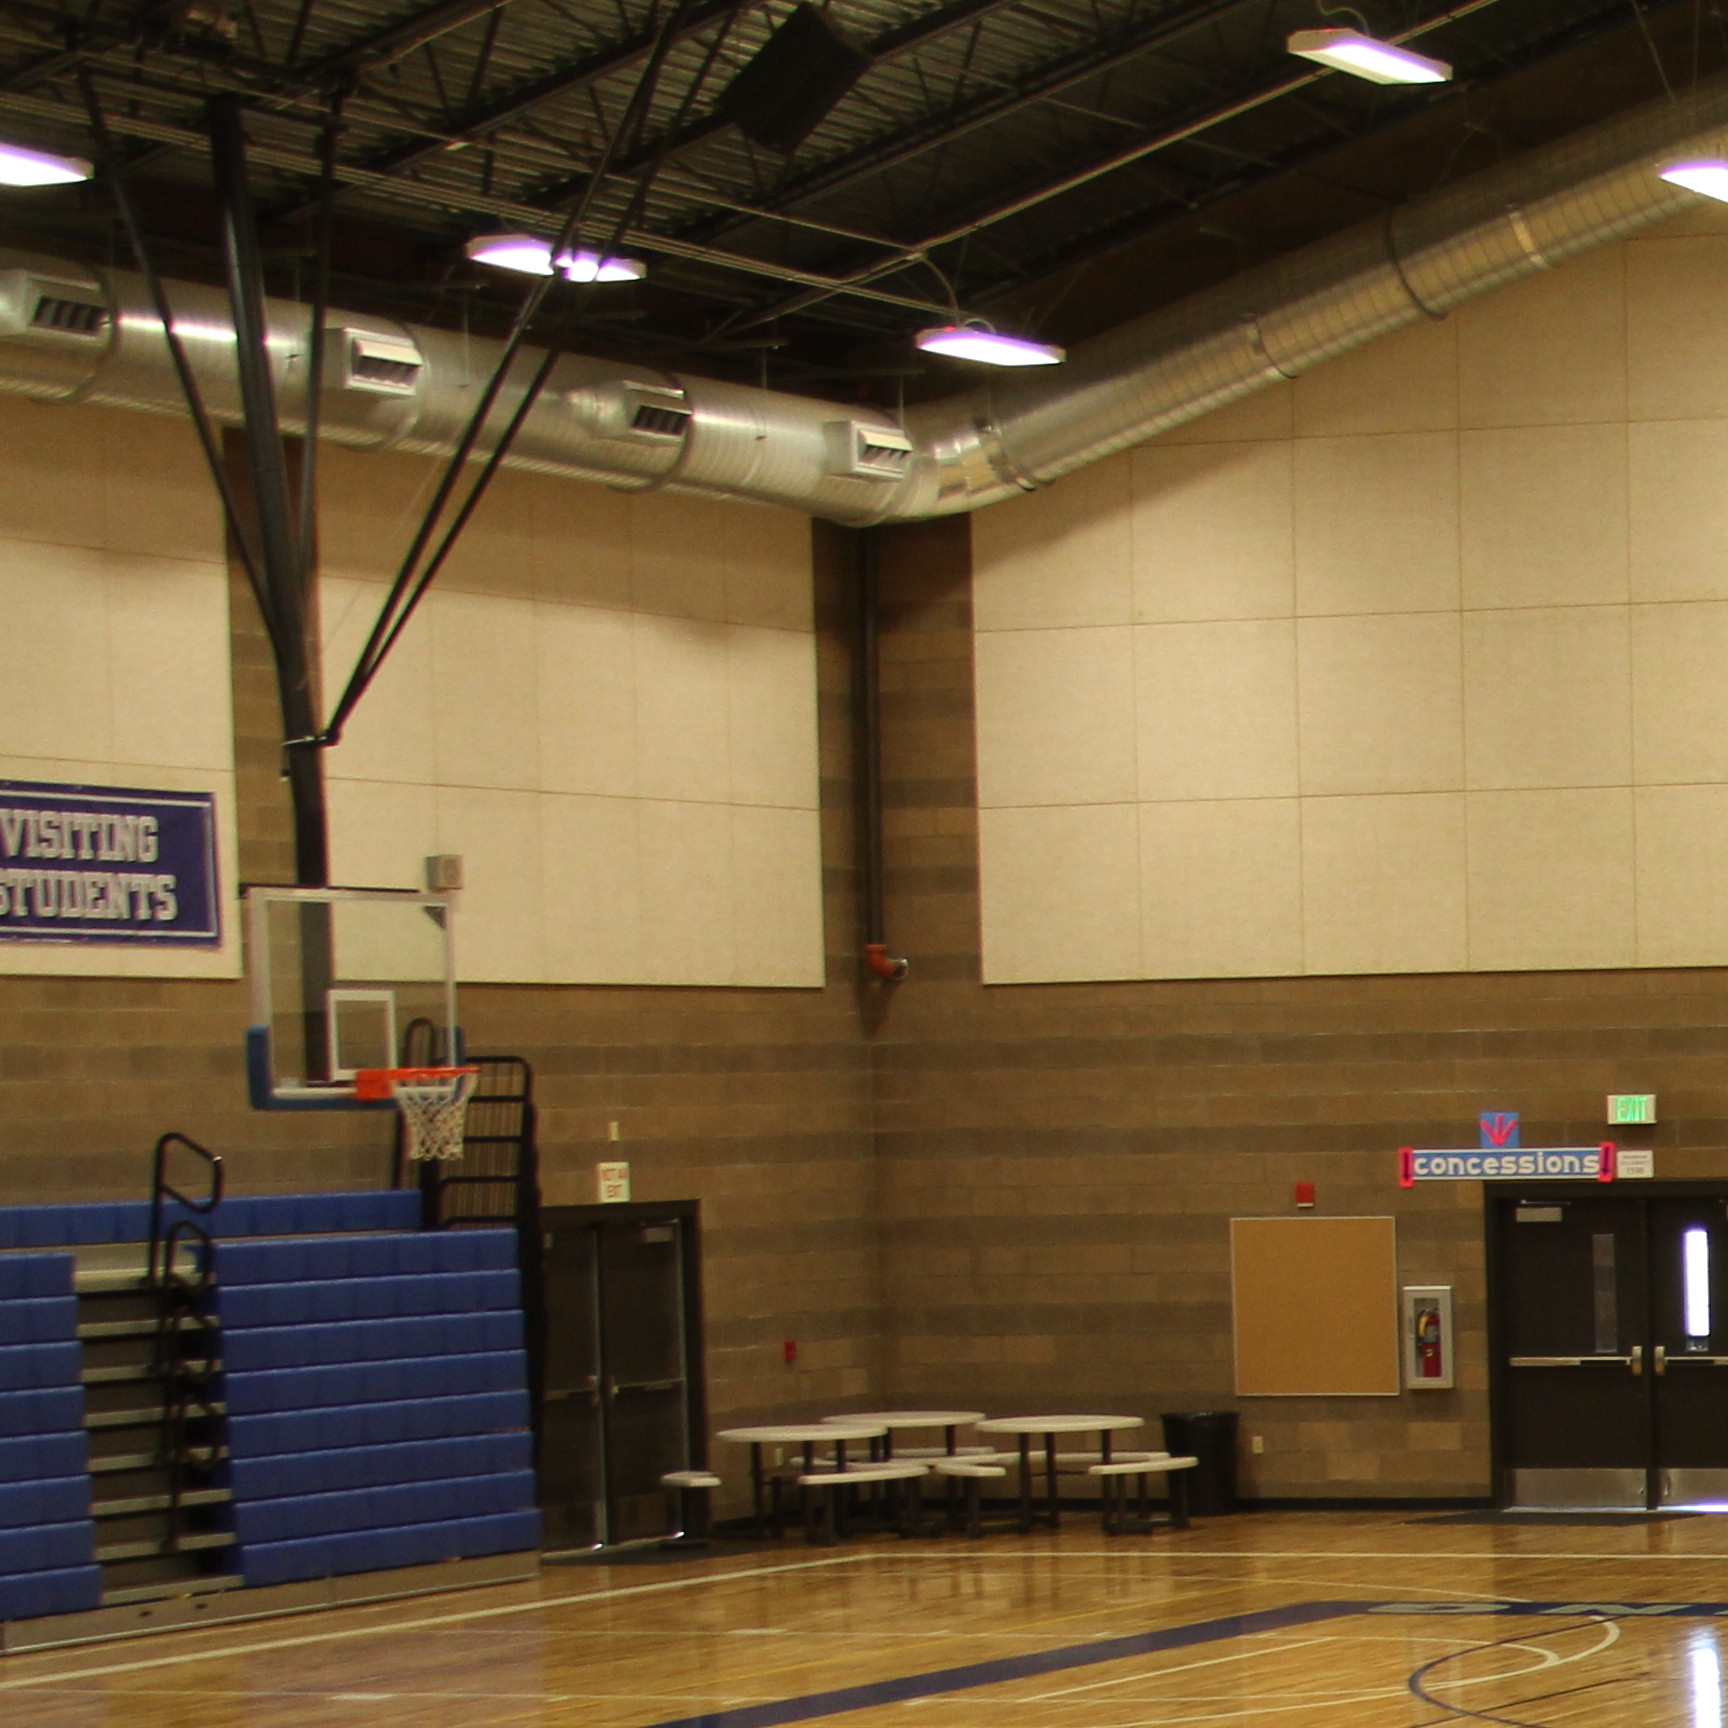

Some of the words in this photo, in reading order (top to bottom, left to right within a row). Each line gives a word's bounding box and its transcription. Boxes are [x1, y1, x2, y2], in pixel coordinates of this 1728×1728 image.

[0, 807, 160, 864] VISITING
[1616, 1095, 1648, 1122] EXIT
[1413, 1151, 1600, 1176] concessions
